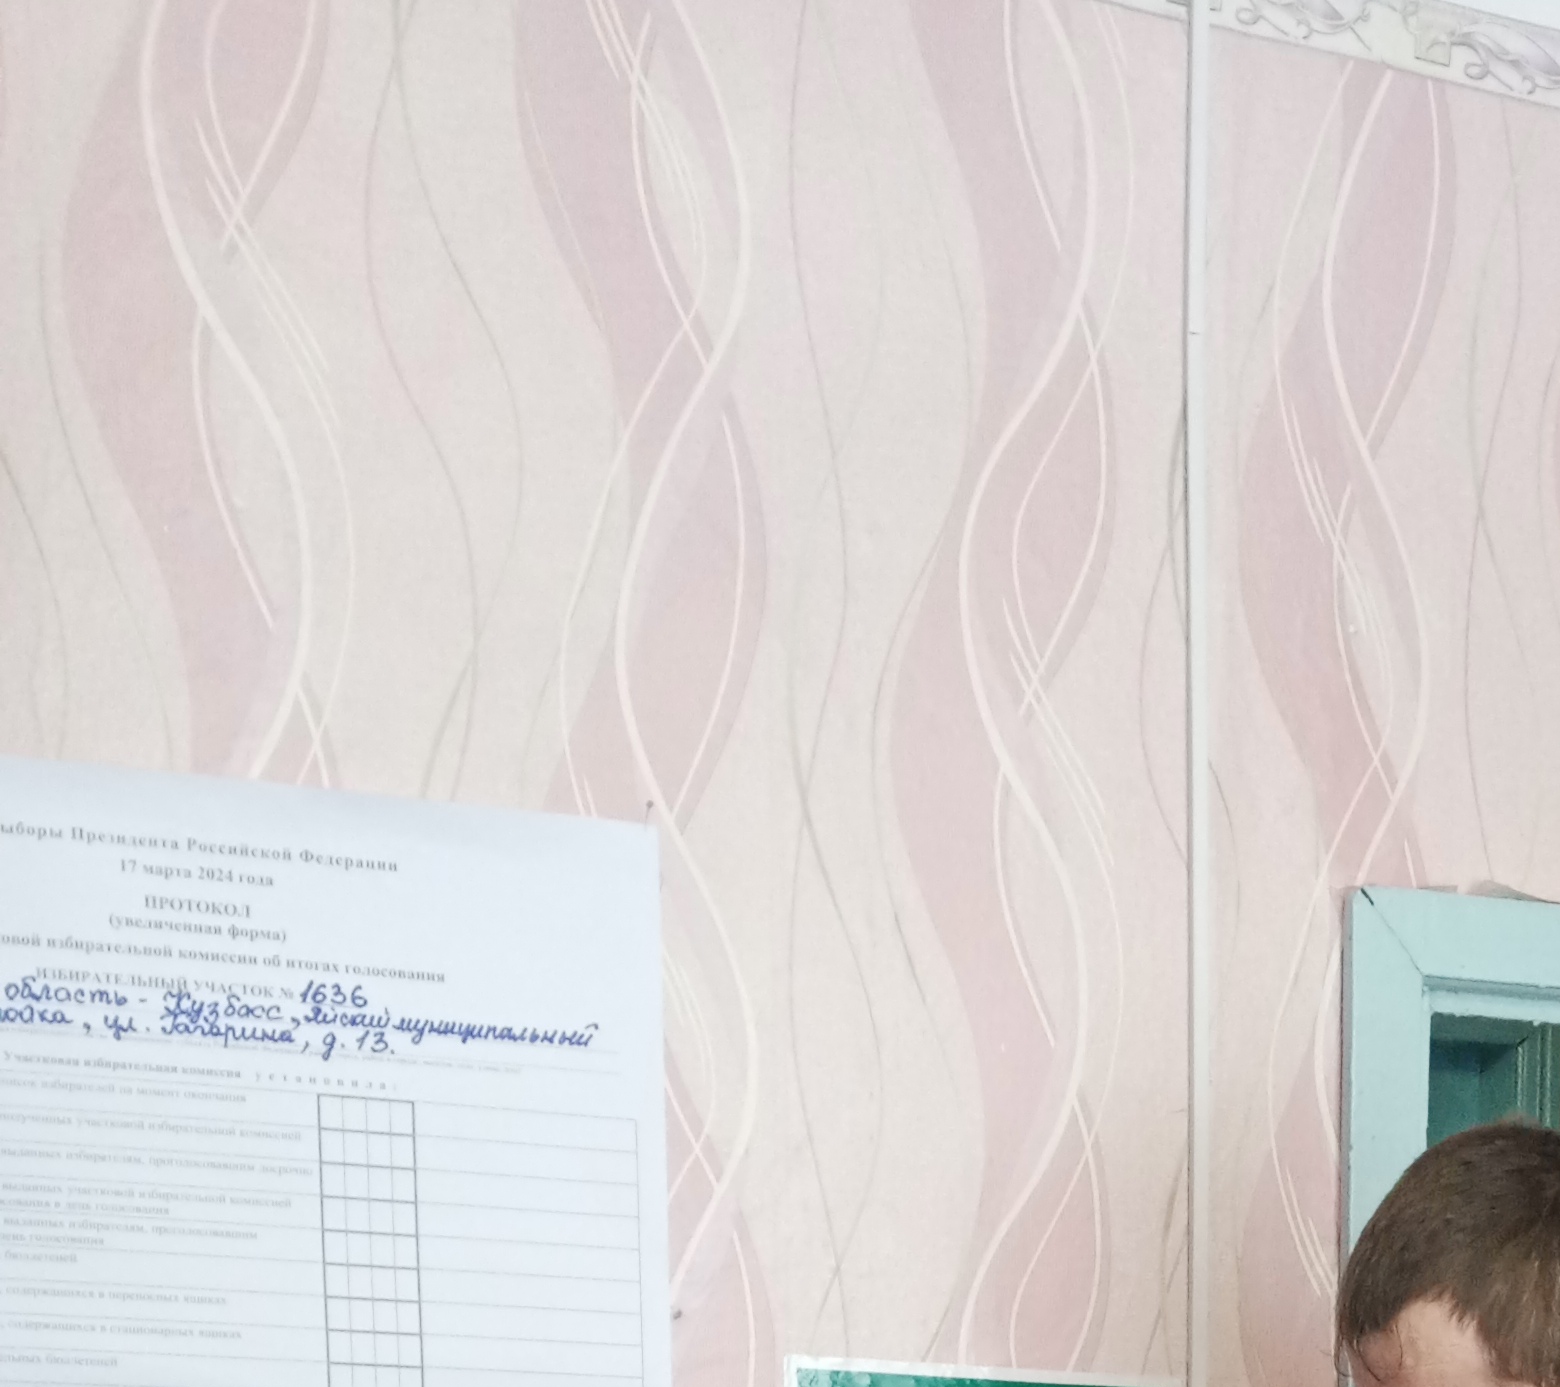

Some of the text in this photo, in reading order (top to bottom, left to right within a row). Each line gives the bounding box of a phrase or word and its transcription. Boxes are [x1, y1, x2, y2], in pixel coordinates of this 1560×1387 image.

[71, 826, 180, 850] Президента
[187, 837, 293, 861] Российской
[299, 849, 399, 872] Федерации
[119, 859, 275, 887] 17 марта 2024 года
[143, 894, 251, 919] ПРОТОКОЛ
[108, 912, 288, 944] (увеличенная форма)
[46, 935, 173, 958] избирательной
[178, 947, 258, 966] комиссии
[262, 955, 281, 968] об
[286, 957, 340, 973] итогах
[345, 964, 446, 983] голосования
[4, 974, 129, 1006] область
[299, 979, 368, 1009] 1636
